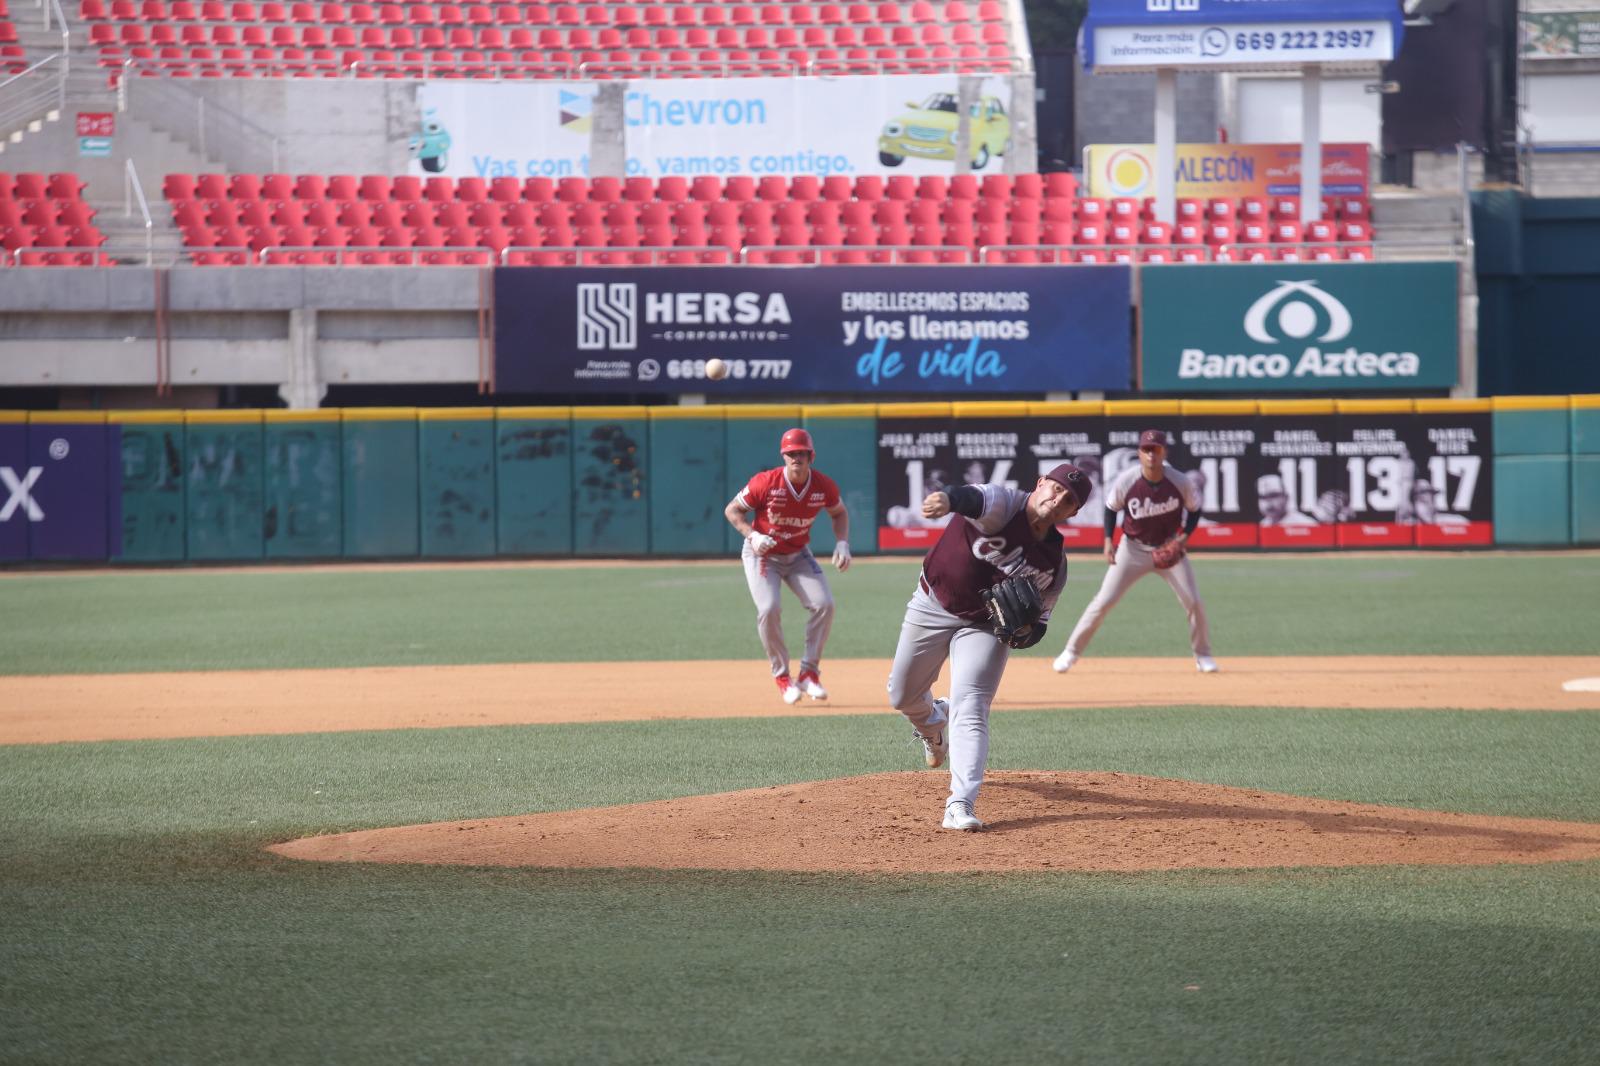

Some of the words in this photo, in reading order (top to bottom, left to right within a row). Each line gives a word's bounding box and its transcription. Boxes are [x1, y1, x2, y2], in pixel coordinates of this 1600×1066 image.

[1236, 33, 1275, 50] 669
[1282, 31, 1319, 49] 222
[1326, 30, 1376, 48] 2997
[624, 91, 766, 127] Chevron
[472, 155, 518, 177] Vas
[527, 158, 572, 177] con
[656, 155, 741, 174] vamos
[749, 150, 855, 177] contigo.
[1174, 155, 1254, 184] ALECÓN
[645, 292, 792, 325] HERSA
[842, 292, 958, 312] EMBELLECEMOS
[960, 291, 1029, 312] ESPACIOS
[843, 318, 861, 346] y
[864, 315, 905, 341] los
[910, 315, 1029, 341] llenamos
[749, 359, 792, 379] 7717
[857, 335, 905, 386] de
[918, 336, 1007, 386] vida
[1179, 348, 1290, 379] Banco
[1293, 347, 1420, 378] Azteca
[1200, 457, 1241, 513] 11
[1277, 457, 1318, 513] 11
[1347, 456, 1401, 512] 13
[1428, 455, 1482, 512] 17
